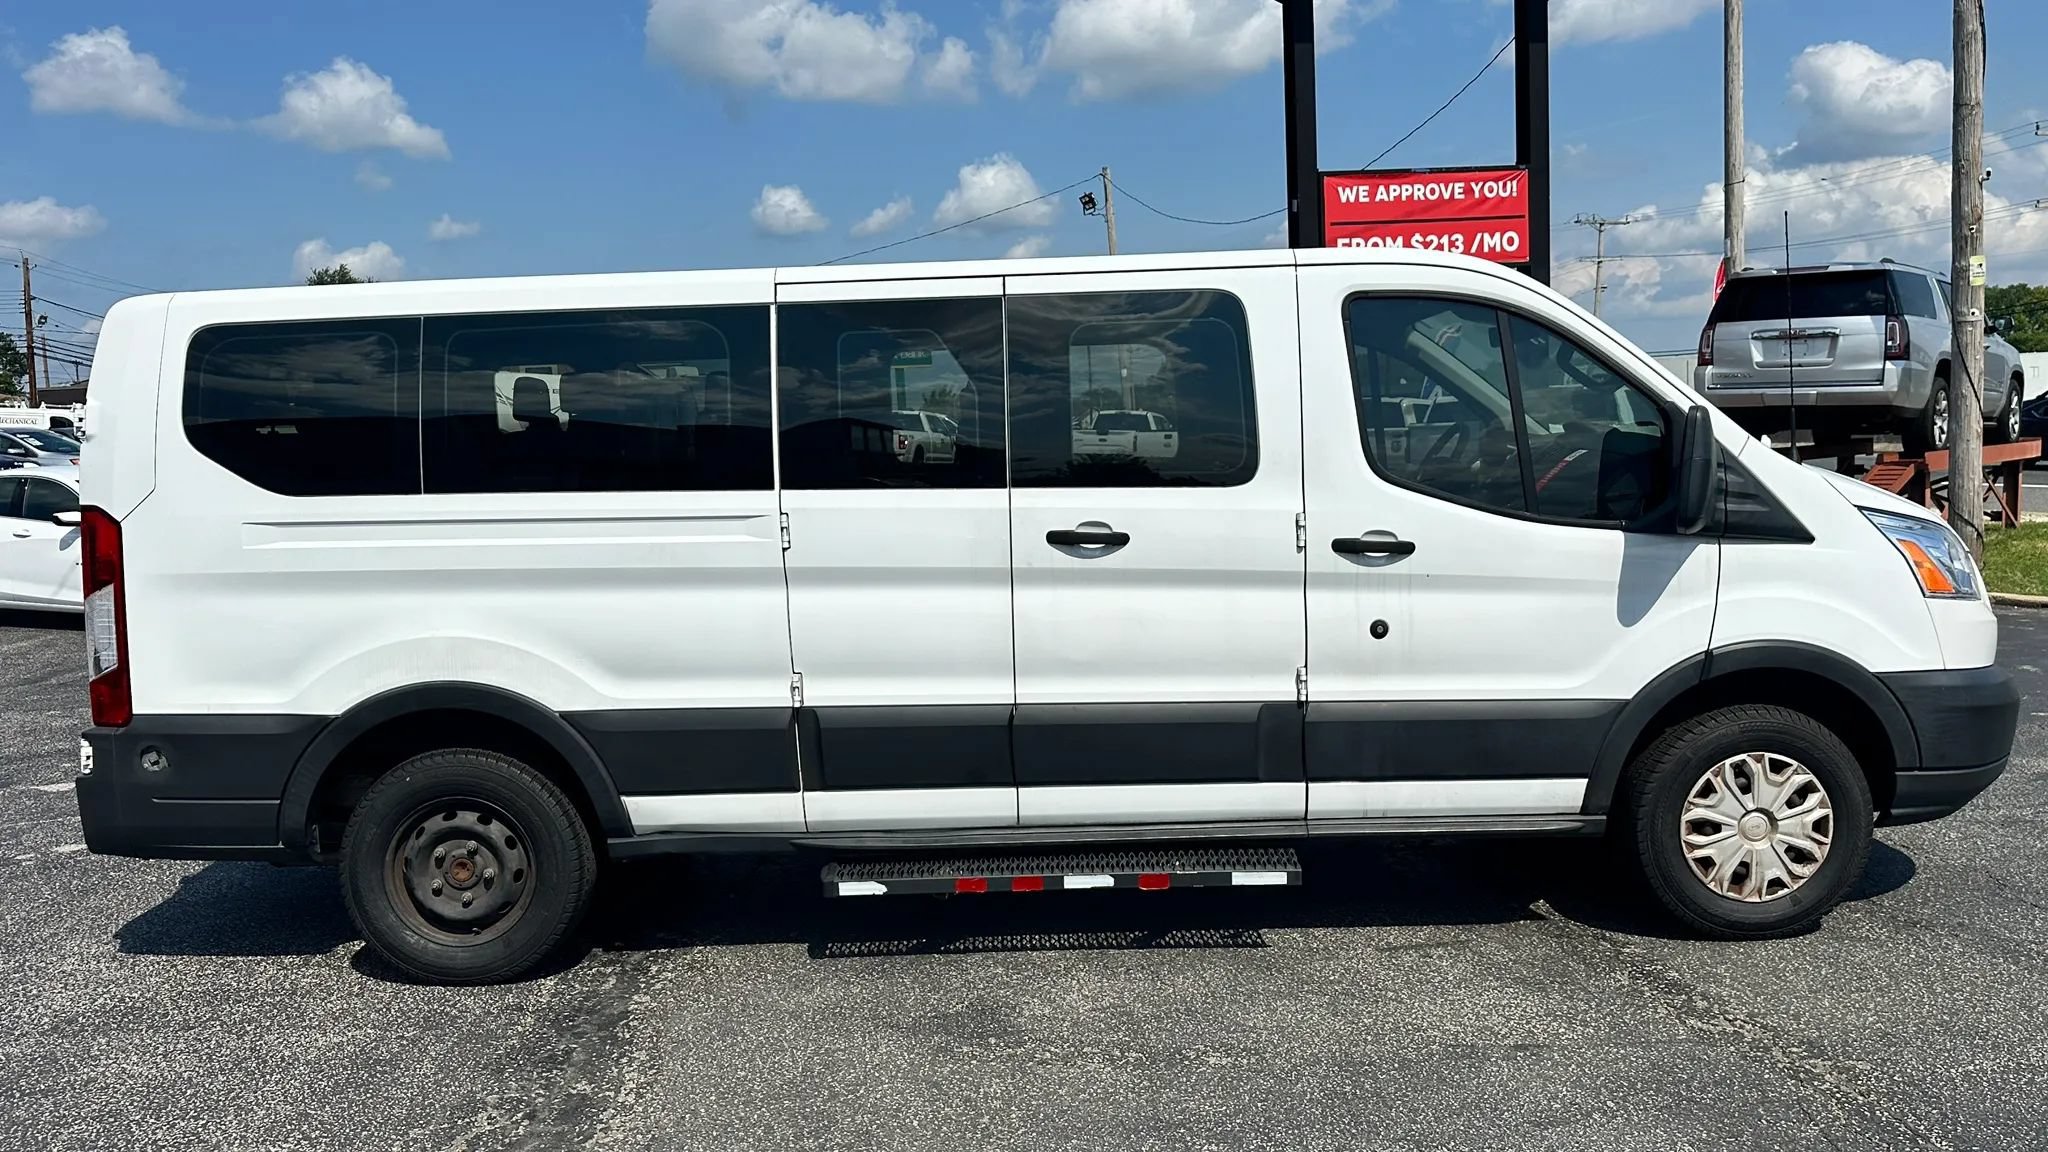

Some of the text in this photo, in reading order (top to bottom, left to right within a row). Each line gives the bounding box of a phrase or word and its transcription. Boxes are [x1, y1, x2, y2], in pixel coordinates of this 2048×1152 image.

[1337, 180, 1518, 203] WE APPROVE YOU!
[1410, 232, 1465, 253] $213
[1470, 230, 1520, 254] /MO
[0, 416, 38, 425] ECHANICAL
